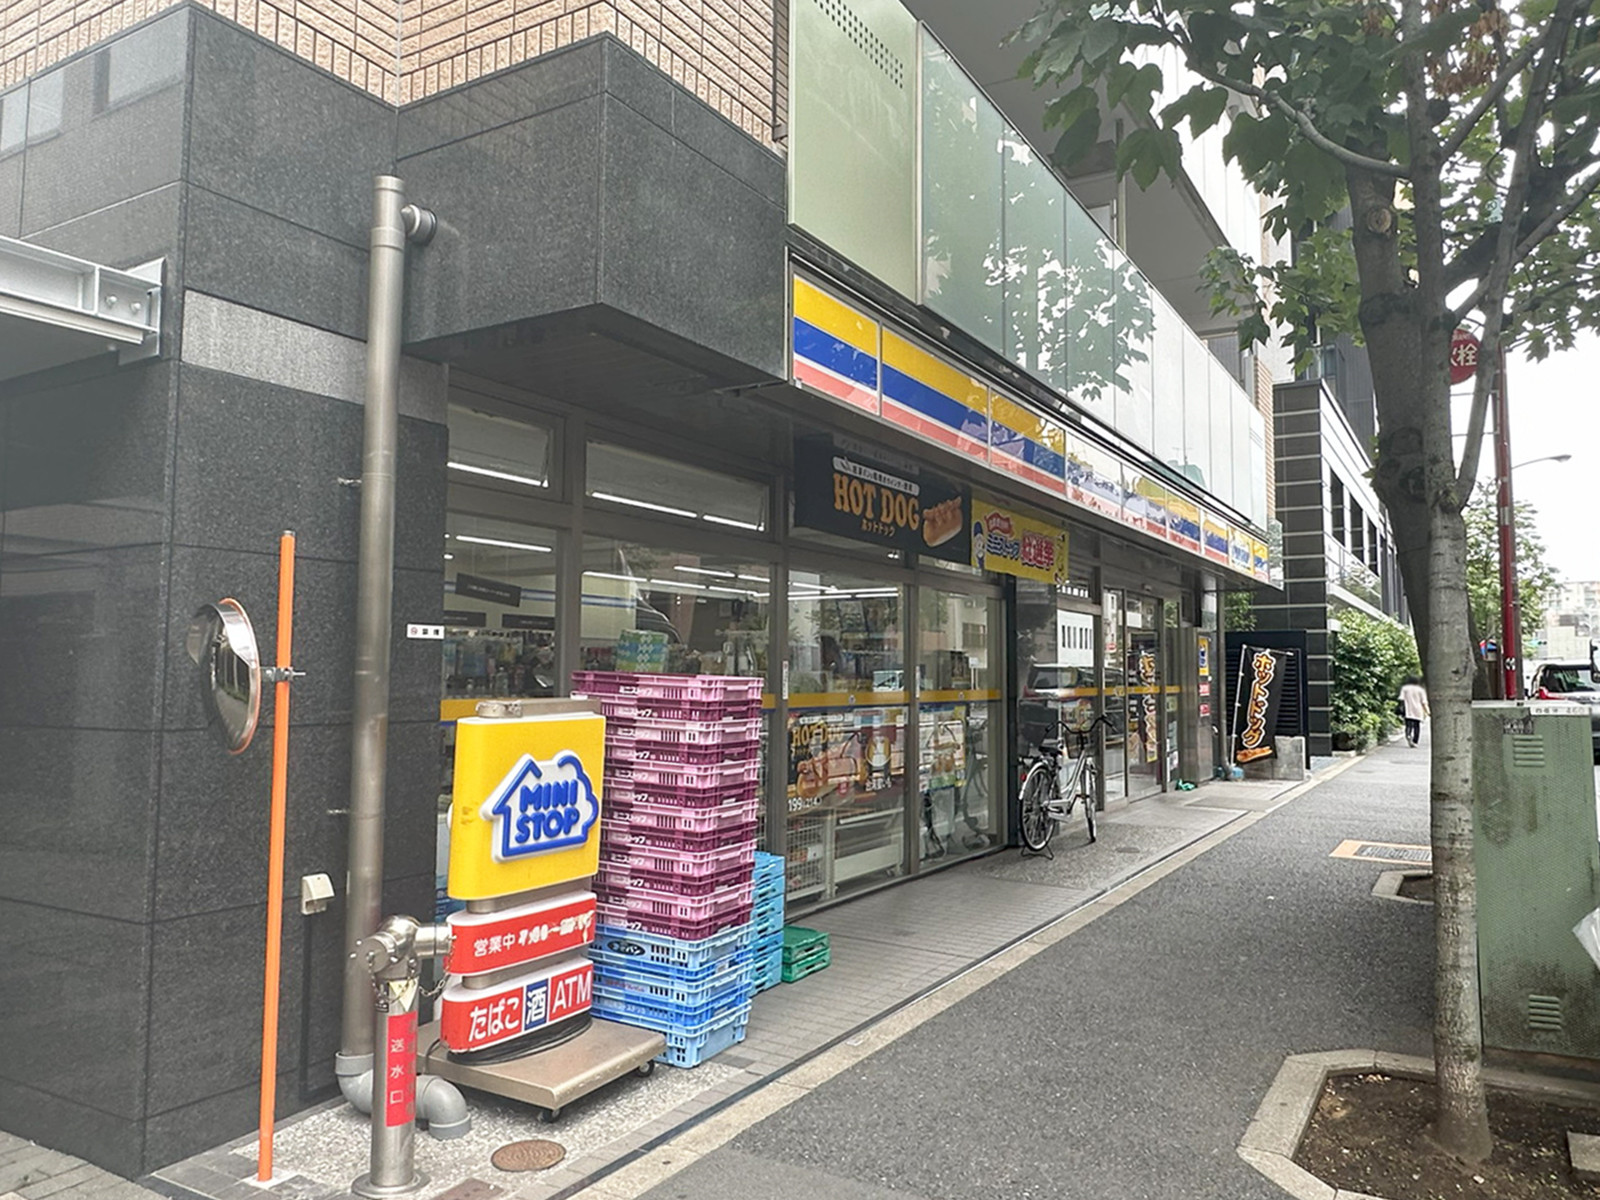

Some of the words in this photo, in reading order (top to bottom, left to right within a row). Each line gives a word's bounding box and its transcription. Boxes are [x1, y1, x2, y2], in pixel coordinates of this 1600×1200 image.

[834, 472, 876, 519] HOT
[881, 488, 920, 530] DOG
[1243, 653, 1275, 747] ホットドッグ
[519, 779, 578, 813] MINI
[515, 807, 580, 844] STOP
[474, 933, 515, 957] 営業中
[469, 998, 519, 1042] たばこ
[526, 986, 548, 1024] 酒
[552, 970, 592, 1013] ATM
[390, 1038, 405, 1104] 送水口
